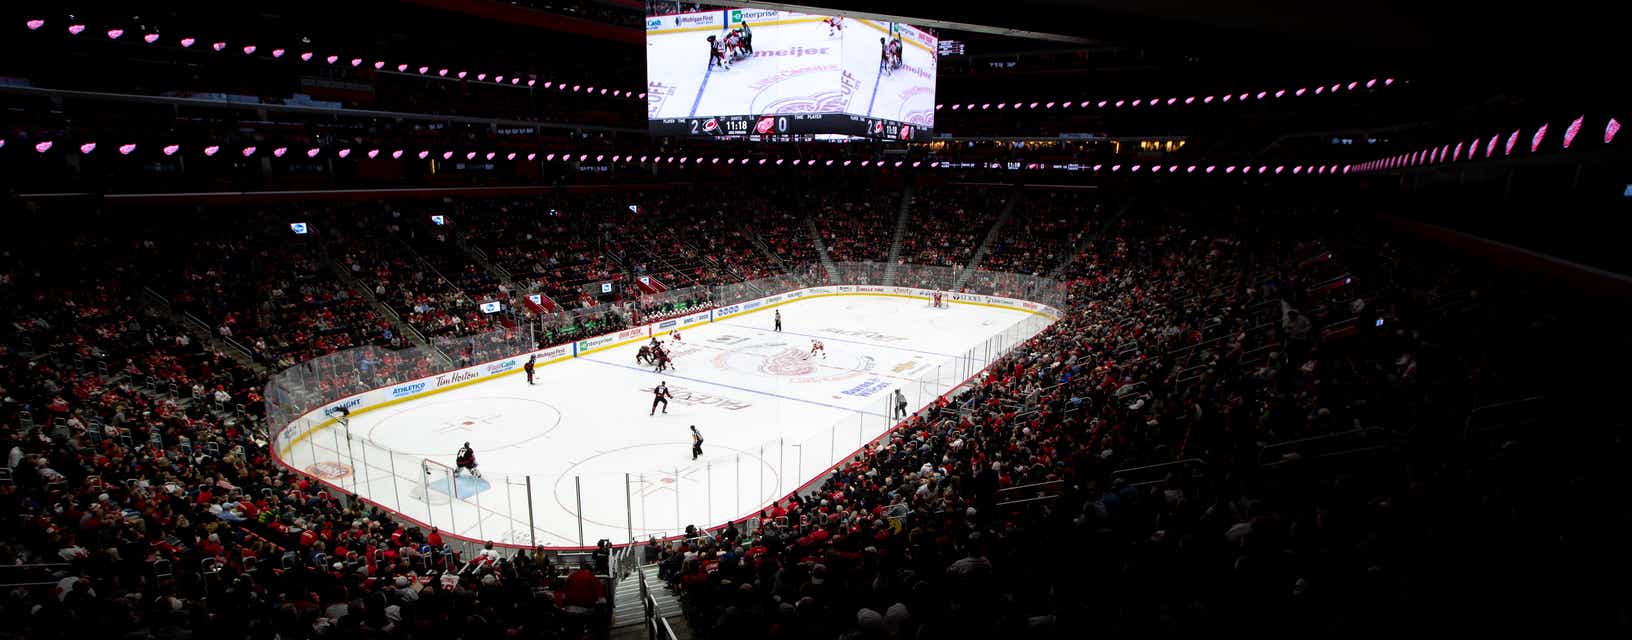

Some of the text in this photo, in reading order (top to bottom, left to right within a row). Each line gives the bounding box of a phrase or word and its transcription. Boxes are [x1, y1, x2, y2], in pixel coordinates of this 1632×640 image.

[753, 46, 830, 57] meijer
[691, 119, 699, 135] 2
[727, 121, 747, 131] 11:18
[779, 116, 787, 132] 0
[867, 119, 873, 135] 2
[436, 371, 480, 388] Tim Hortons
[393, 382, 426, 395] ATHLETICO
